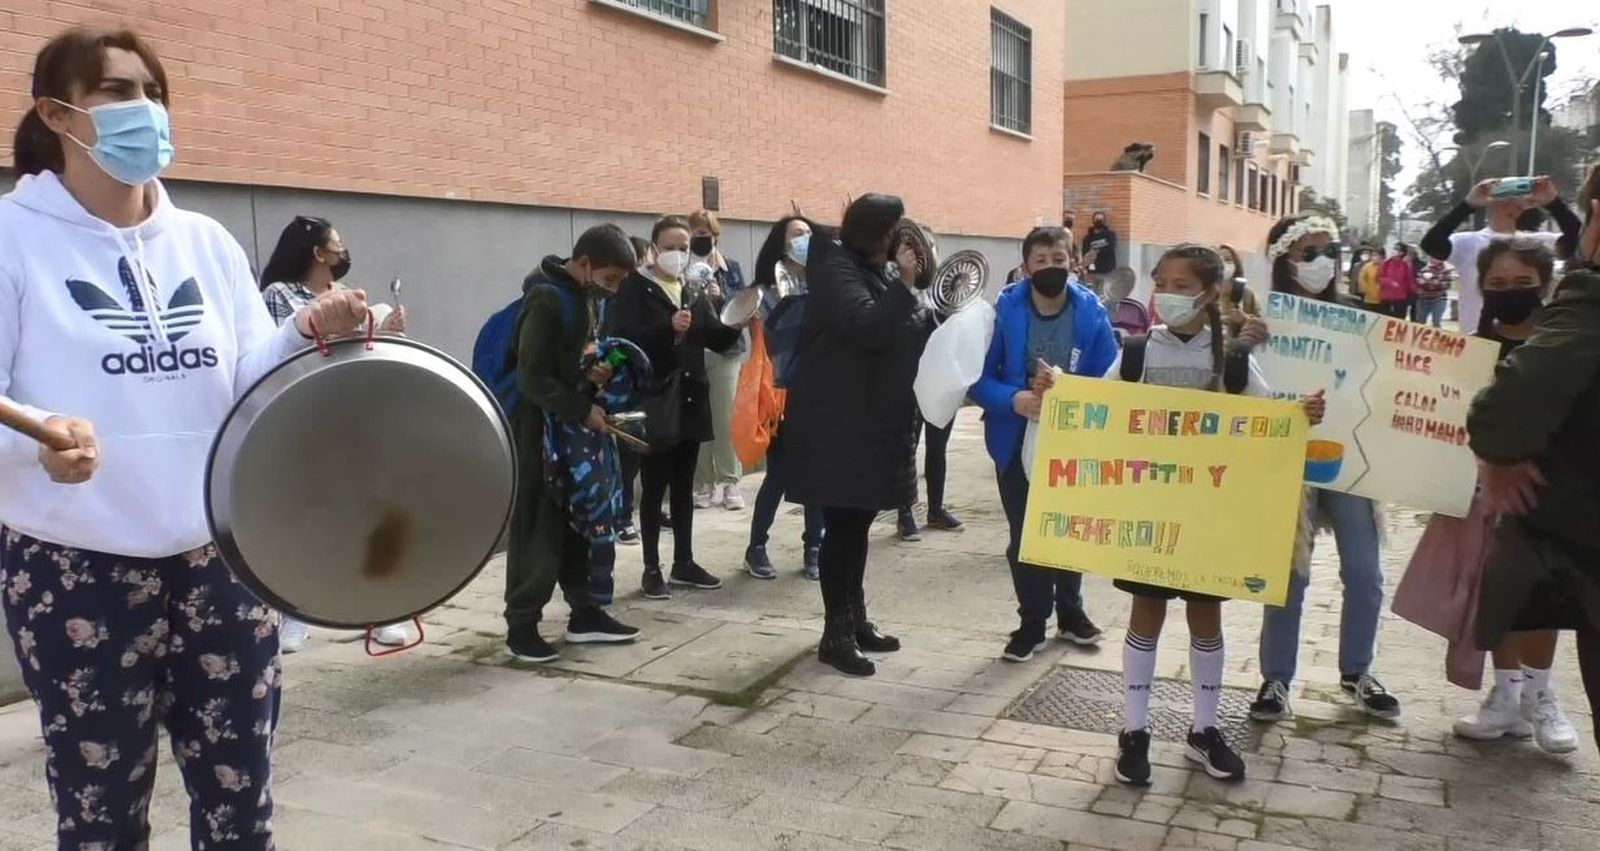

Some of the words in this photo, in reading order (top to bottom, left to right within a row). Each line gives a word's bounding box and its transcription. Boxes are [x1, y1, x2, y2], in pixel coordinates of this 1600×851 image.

[1267, 293, 1295, 320] EN
[1384, 320, 1408, 343] EN
[101, 344, 218, 375] adidas
[1334, 369, 1347, 390] Y
[1128, 408, 1221, 436] ENERO
[1229, 414, 1292, 438] CON
[1208, 464, 1228, 488] Y
